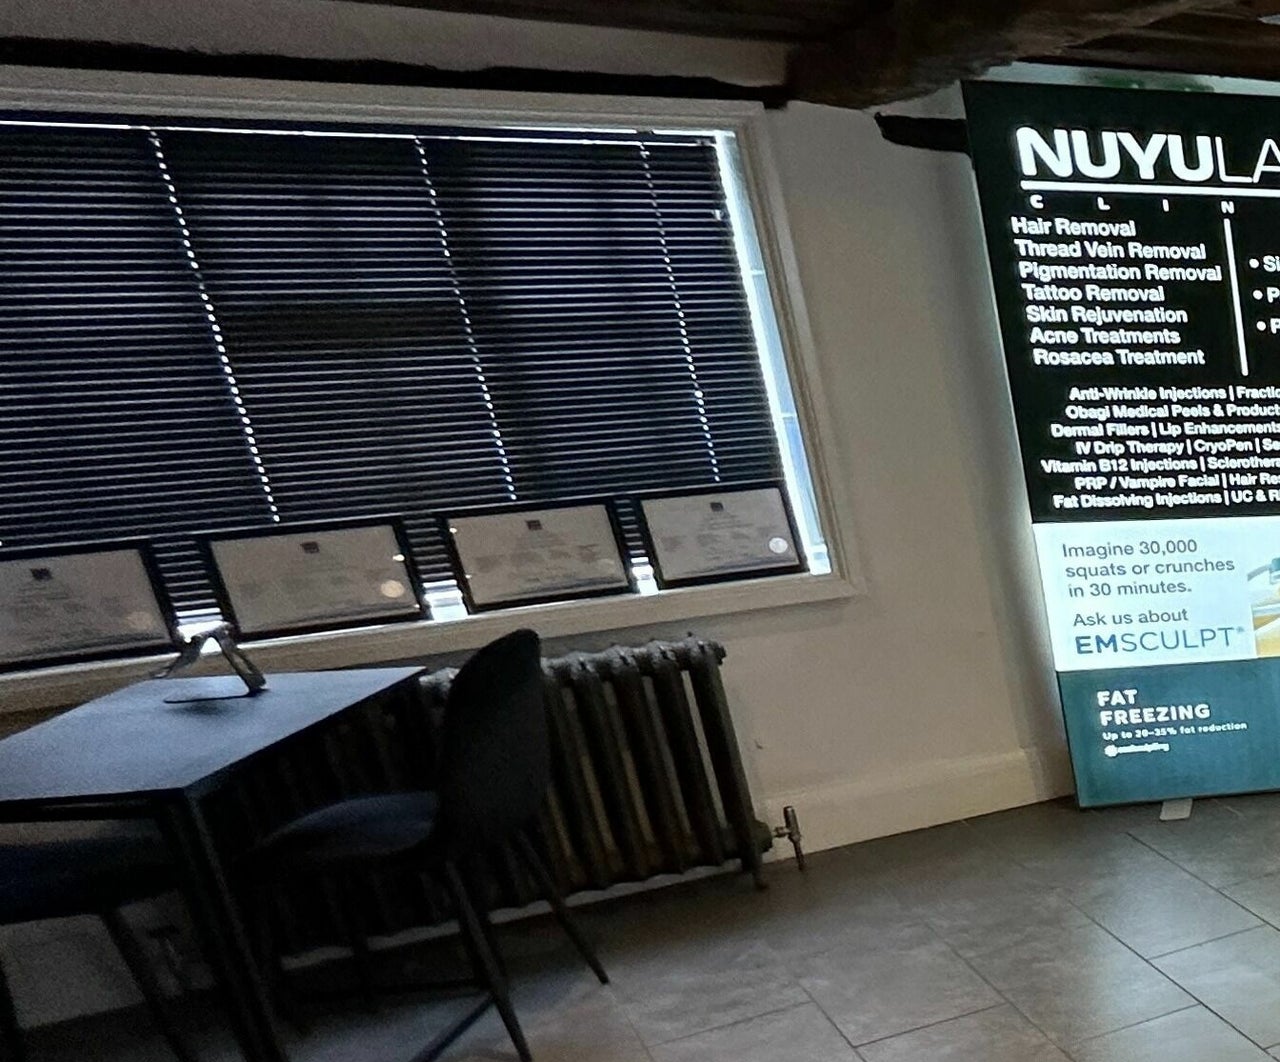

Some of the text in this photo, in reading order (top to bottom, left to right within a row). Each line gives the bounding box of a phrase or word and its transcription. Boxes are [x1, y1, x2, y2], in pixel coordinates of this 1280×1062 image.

[1011, 217, 1136, 236] Hair Removal
[1014, 239, 1206, 259] Thread Vein Removal
[1019, 261, 1222, 282] Pigmentation Removal
[1021, 283, 1165, 301] Tattoo Removal
[1026, 305, 1188, 326] Skin Rejuvenation
[1030, 327, 1181, 344] Acne Treatments
[1033, 348, 1205, 365] Rosacea Treatment
[1069, 387, 1157, 400] Anti-Wrinkle
[1159, 387, 1227, 402] Injections
[1065, 405, 1110, 421] Obagi
[1113, 405, 1169, 418] Medical
[1172, 404, 1211, 417] Peels
[1051, 423, 1104, 437] Dermal
[1106, 423, 1150, 436] Fillers
[1159, 423, 1182, 437] Lip
[1076, 441, 1091, 455] IV
[1093, 441, 1125, 456] Drip
[1126, 440, 1184, 455] Therapy
[1194, 439, 1253, 454] CryoPen
[1041, 459, 1097, 473] Vitamin
[1099, 459, 1128, 472] B12
[1131, 458, 1198, 473] Injections
[1074, 477, 1107, 490] PRP
[1118, 476, 1176, 490] Vampire
[1178, 474, 1220, 487] Facial
[1229, 473, 1257, 485] Hair
[1053, 495, 1079, 508] Fat
[1081, 494, 1153, 508] Dissolving
[1155, 492, 1222, 507] Injections
[1063, 539, 1197, 559] Imagine 30,000
[1066, 559, 1234, 579] squats or crunches
[1069, 581, 1191, 597] in 30 minutes.
[1074, 609, 1188, 626] Ask us about
[1097, 689, 1137, 706] FAT
[1100, 704, 1210, 726] FREEZING
[1102, 732, 1118, 741] Up
[1180, 726, 1195, 734] fat
[1198, 723, 1247, 732] reduction
